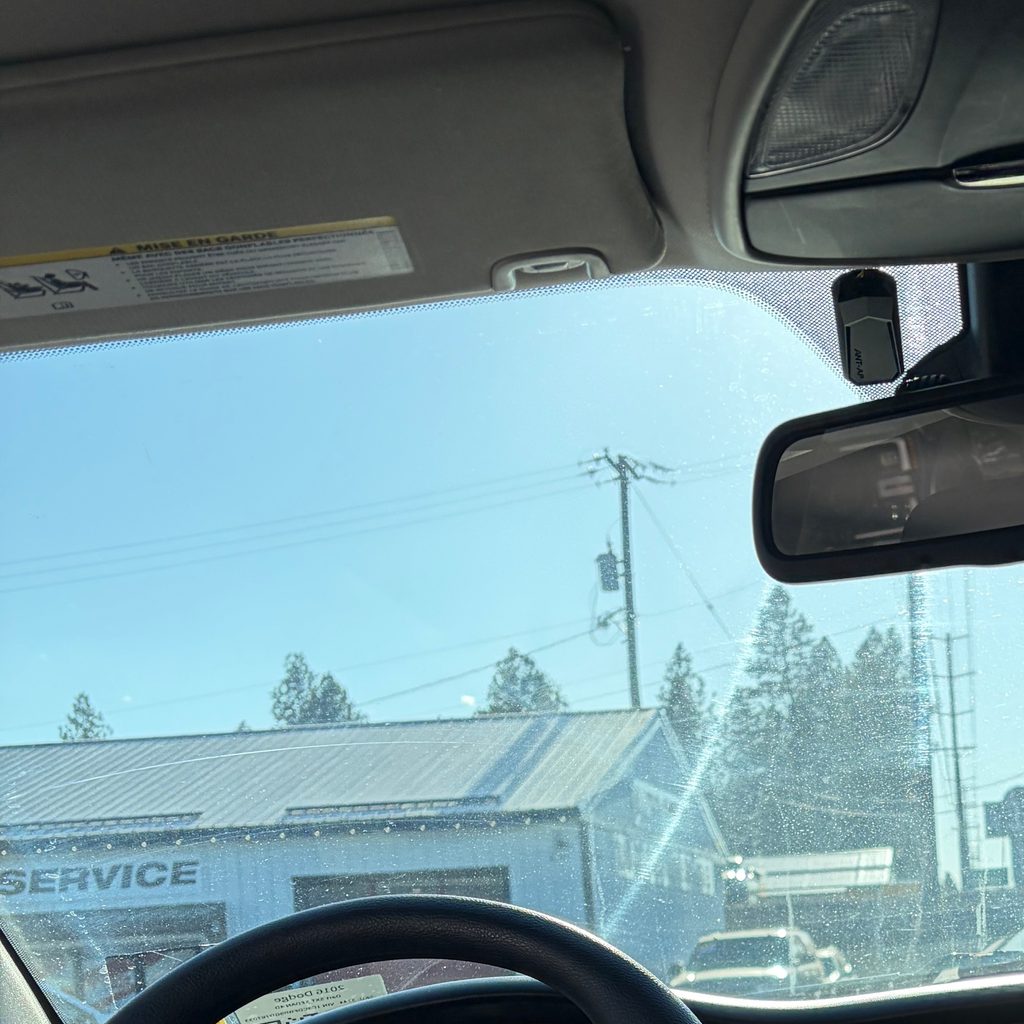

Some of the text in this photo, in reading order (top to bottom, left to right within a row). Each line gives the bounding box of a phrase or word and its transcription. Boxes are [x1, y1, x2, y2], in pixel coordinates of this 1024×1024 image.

[136, 230, 278, 253] MISE EN GARDE
[0, 859, 200, 897] SERVICE
